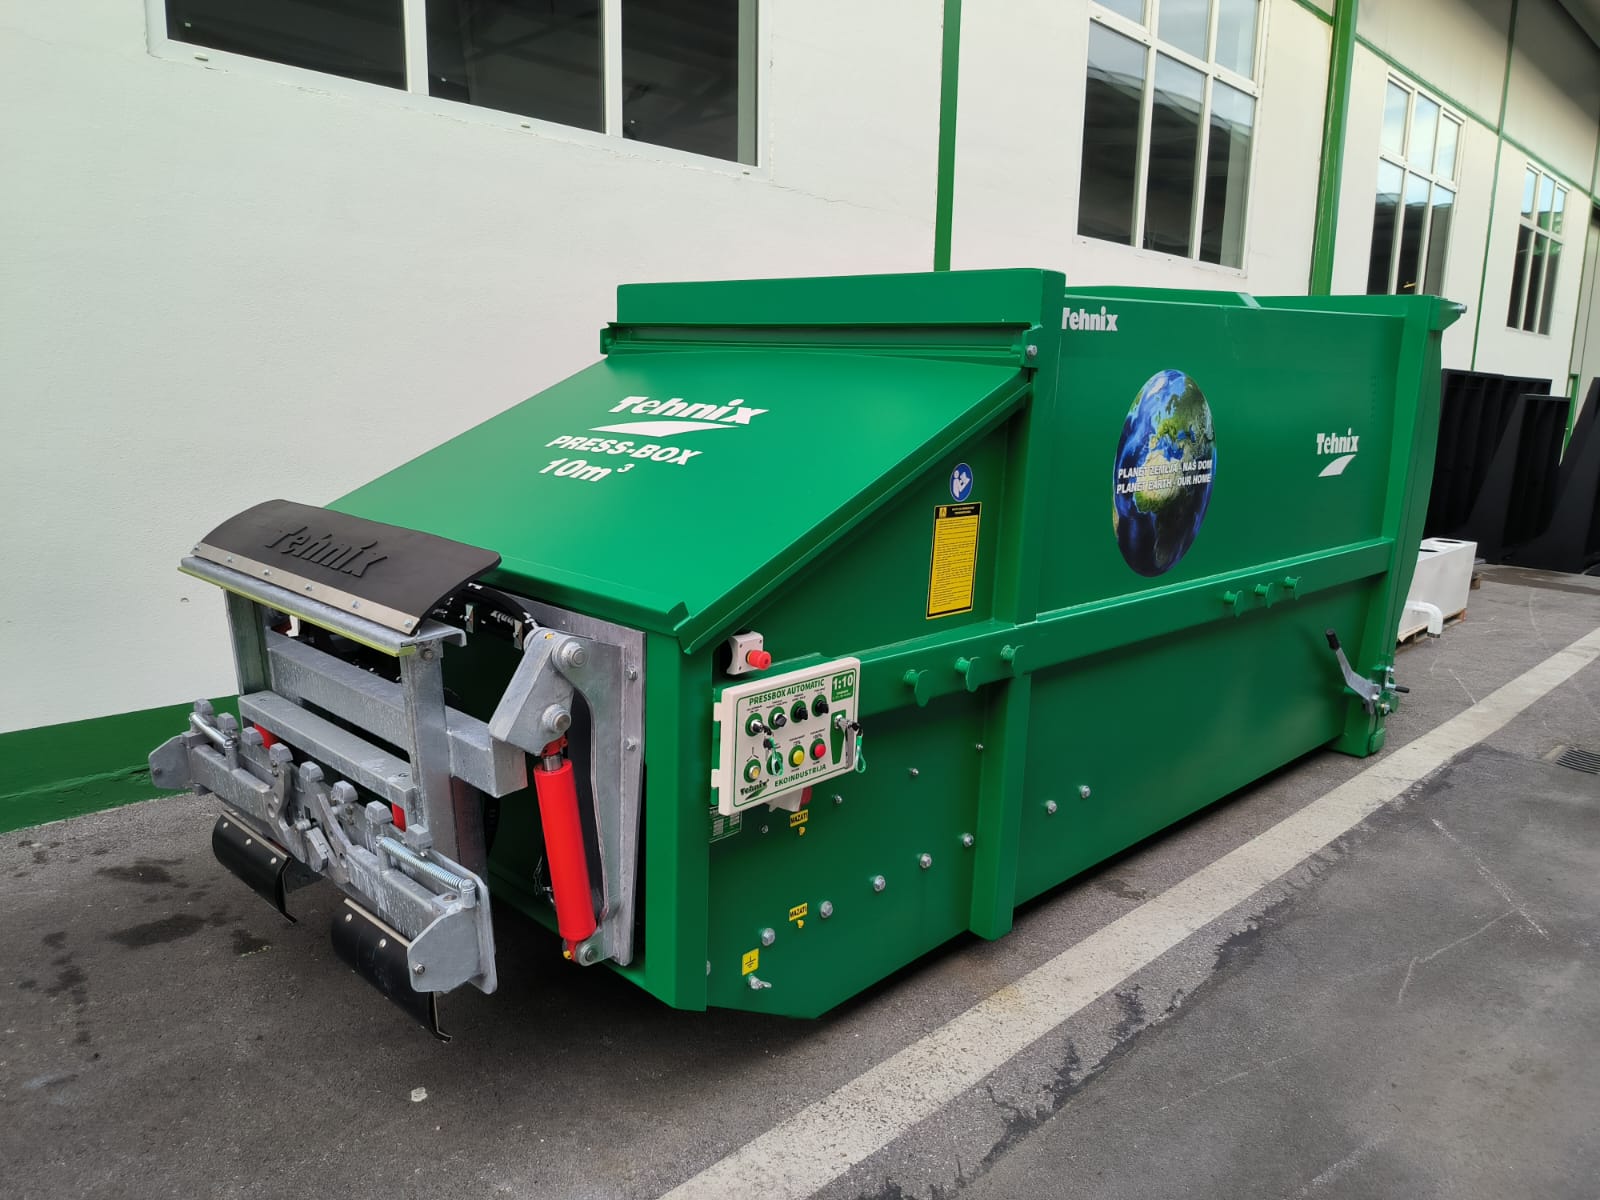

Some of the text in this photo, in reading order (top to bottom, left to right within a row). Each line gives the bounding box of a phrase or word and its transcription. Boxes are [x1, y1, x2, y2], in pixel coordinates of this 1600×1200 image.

[1061, 305, 1118, 332] Tehnix
[607, 395, 769, 425] Tehnix
[544, 435, 703, 466] PRESS-BOX
[1316, 427, 1360, 455] Tehnix
[1118, 466, 1147, 480] PLANET
[1149, 462, 1178, 477] ZEMLJA
[1198, 459, 1213, 470] DOM
[1116, 480, 1146, 495] PLANET
[1148, 478, 1172, 491] EARTH
[1177, 476, 1192, 487] OUR
[1192, 473, 1212, 485] HOME
[264, 526, 388, 578] Tehnix
[748, 689, 787, 706] PRESSBOX
[786, 678, 825, 697] AUTOMATIC
[832, 674, 854, 691] 1:10
[740, 778, 770, 796] Tehnix
[774, 763, 827, 788] EKOINDUSTRIJA
